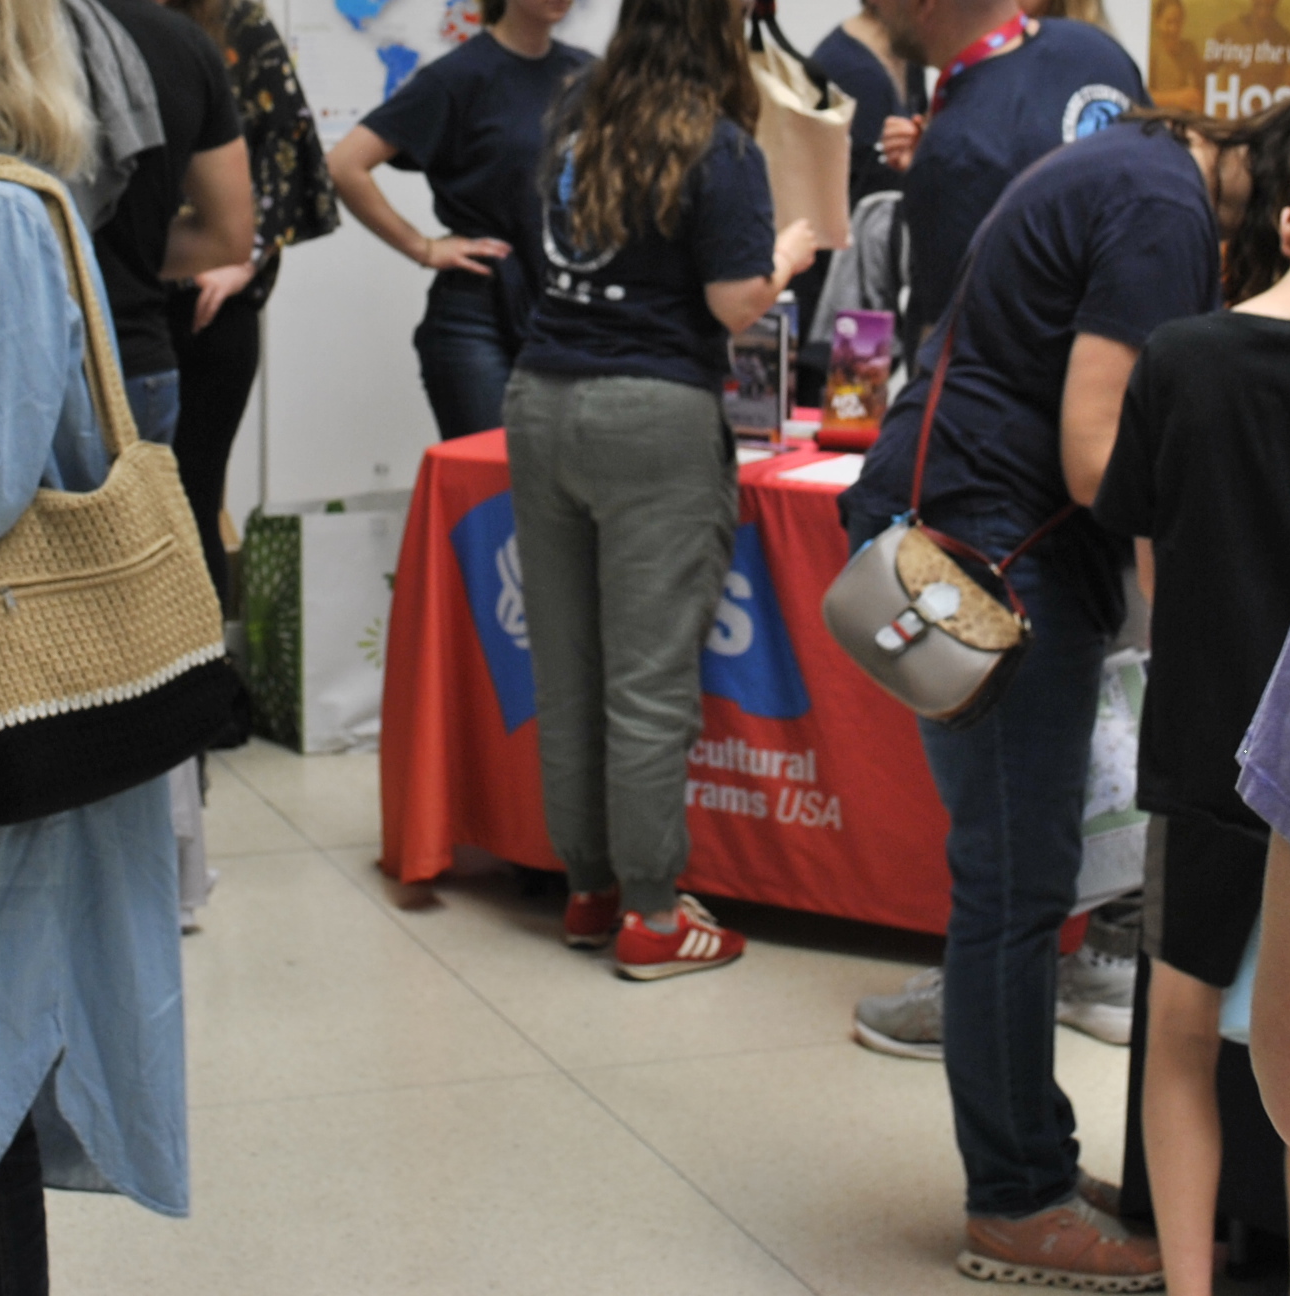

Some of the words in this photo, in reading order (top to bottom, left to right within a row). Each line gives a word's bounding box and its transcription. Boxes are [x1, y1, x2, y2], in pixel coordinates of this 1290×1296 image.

[1203, 38, 1254, 68] Bring
[1254, 39, 1282, 65] the
[688, 736, 817, 783] cultural
[774, 786, 843, 831] USA
